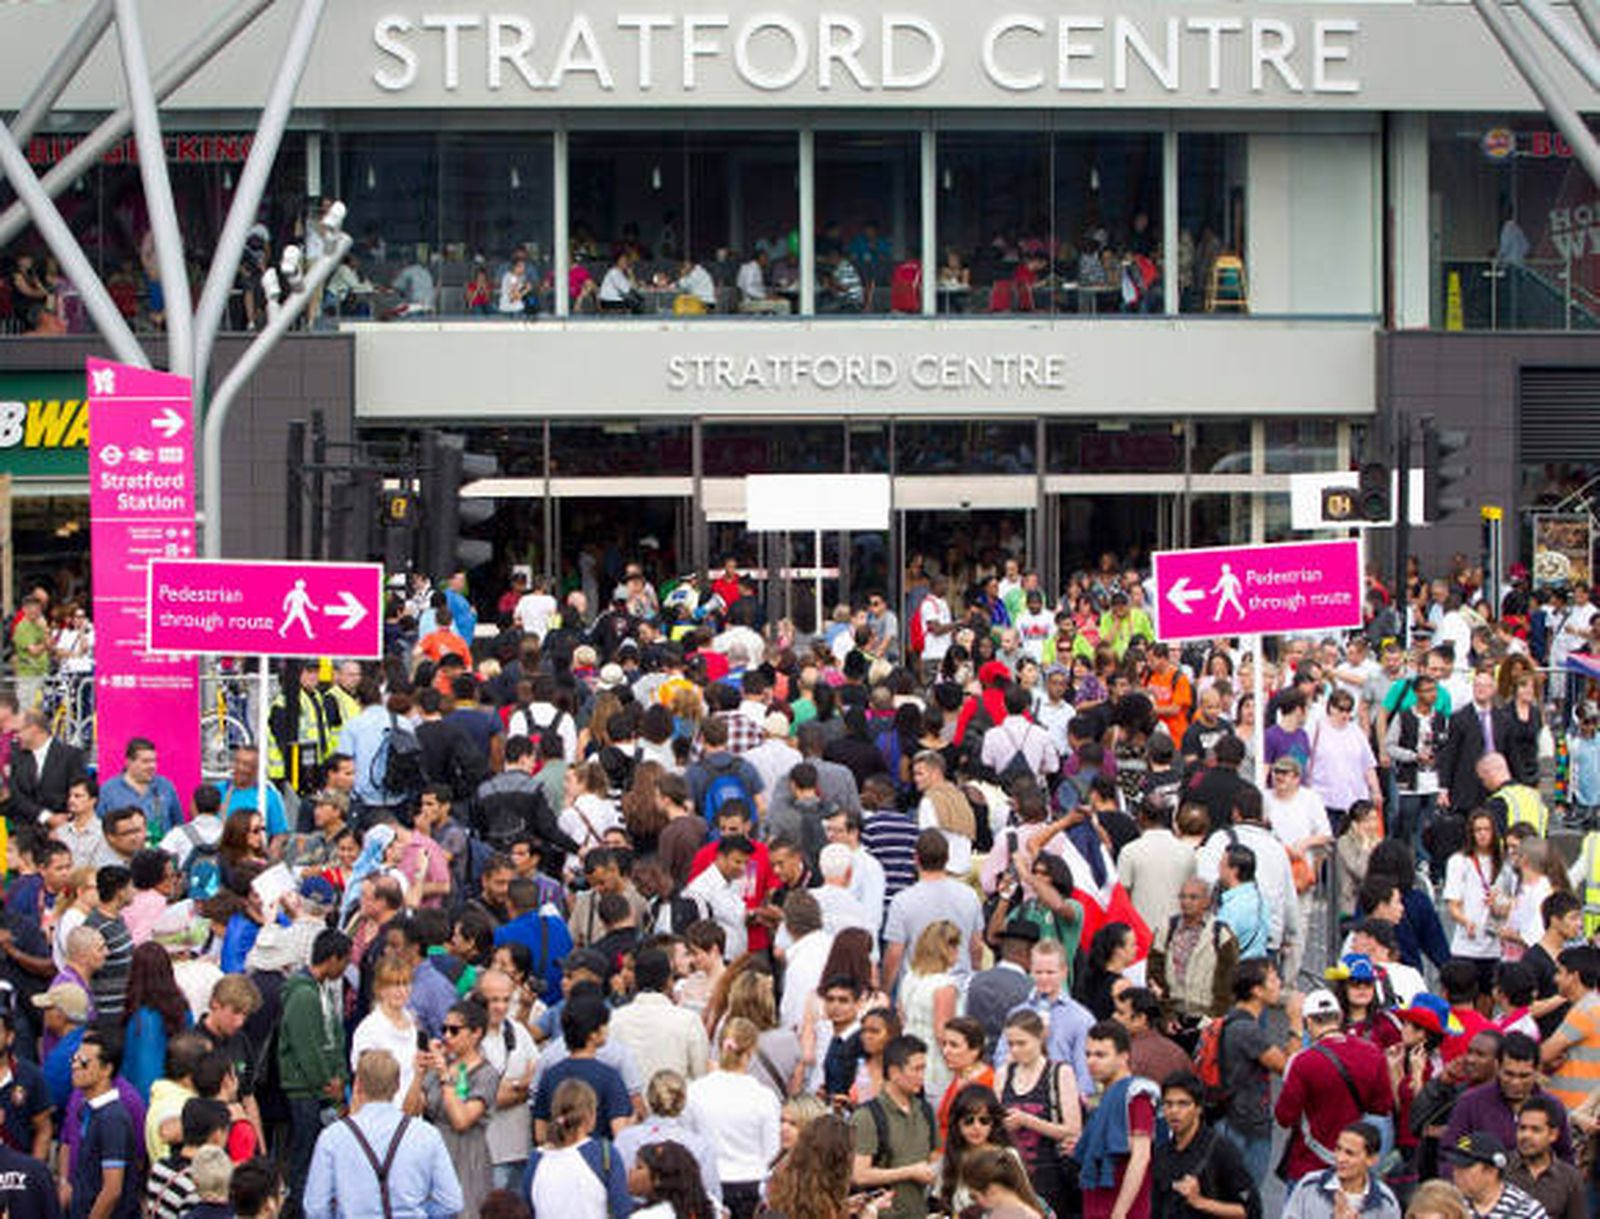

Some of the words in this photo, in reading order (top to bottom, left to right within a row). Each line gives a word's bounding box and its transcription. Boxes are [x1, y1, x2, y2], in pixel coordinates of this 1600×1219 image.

[371, 15, 944, 93] STRATFORD
[981, 16, 1362, 93] CENTRE
[27, 135, 168, 164] BUGE
[667, 353, 898, 391] STRATFORD
[911, 353, 1066, 391] CENTRE
[101, 470, 185, 490] Stratford
[117, 492, 186, 512] Station
[1245, 567, 1322, 586] Pedestrian
[159, 583, 243, 603] Pedestrian
[1248, 590, 1307, 613] through
[1309, 591, 1351, 607] route
[159, 611, 225, 633] through
[227, 616, 275, 631] route
